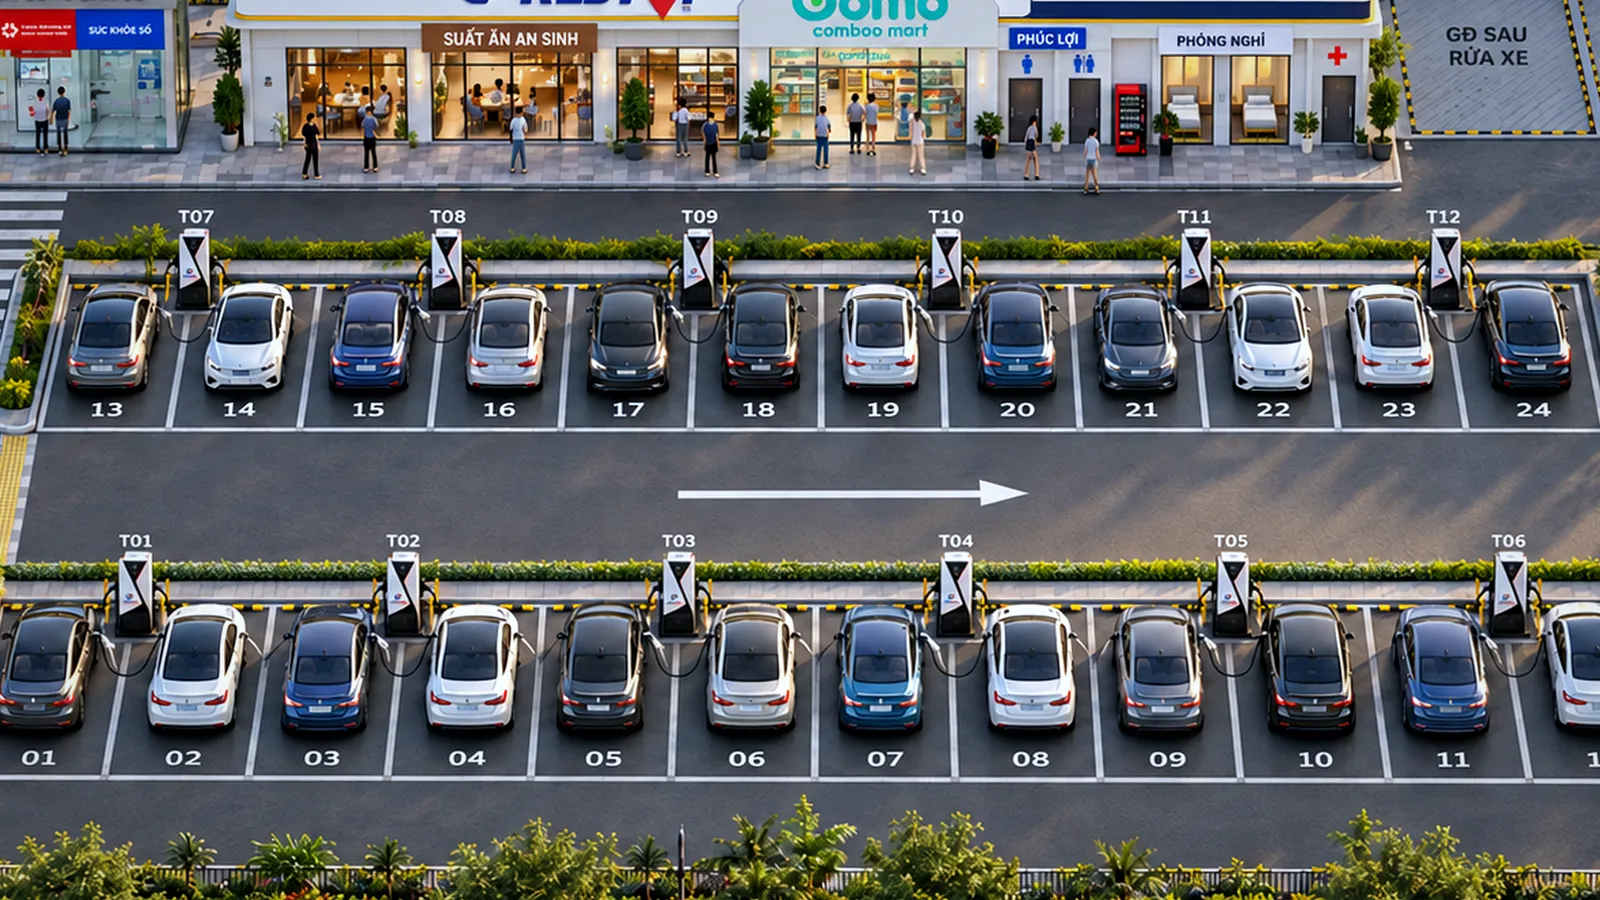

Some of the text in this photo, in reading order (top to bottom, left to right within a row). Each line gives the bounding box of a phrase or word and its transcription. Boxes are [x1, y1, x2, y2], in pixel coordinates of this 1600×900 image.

[443, 26, 578, 46] SUẤT ĂN AN SINH
[812, 22, 929, 38] comboo mart
[1446, 26, 1527, 43] GĐ SAU
[1016, 30, 1079, 49] PHÚC LỢI
[1501, 49, 1529, 66] XE
[177, 209, 215, 224] T07
[429, 209, 467, 224] T08
[681, 209, 719, 224] T09
[927, 209, 964, 225] T10
[1176, 209, 1212, 225] T11
[1425, 209, 1461, 225] T12
[91, 402, 123, 417] 13
[224, 402, 256, 417] 14
[353, 402, 385, 417] 15
[484, 402, 516, 417] 16
[613, 402, 645, 418] 17
[743, 402, 776, 418] 18
[867, 402, 900, 418] 19
[1000, 402, 1036, 418] 20
[1125, 402, 1159, 418] 21
[1257, 402, 1291, 417] 22
[1382, 402, 1416, 418] 23
[1516, 402, 1552, 417] 24
[118, 533, 153, 548] T01
[385, 533, 421, 548] T02
[661, 533, 696, 549] T03
[937, 533, 974, 549] T04
[1212, 533, 1249, 549] T05
[1490, 533, 1527, 549] T06
[21, 750, 56, 766] 01
[165, 750, 202, 766] 02
[304, 750, 340, 766] 03
[448, 750, 486, 767] 04
[585, 750, 622, 767] 05
[728, 751, 766, 767] 06
[867, 751, 904, 767] 07
[1012, 751, 1050, 767] 08
[1149, 751, 1187, 768] 09
[1299, 751, 1333, 768] 10
[1437, 751, 1470, 768] 11
[1587, 751, 1600, 768] 1
